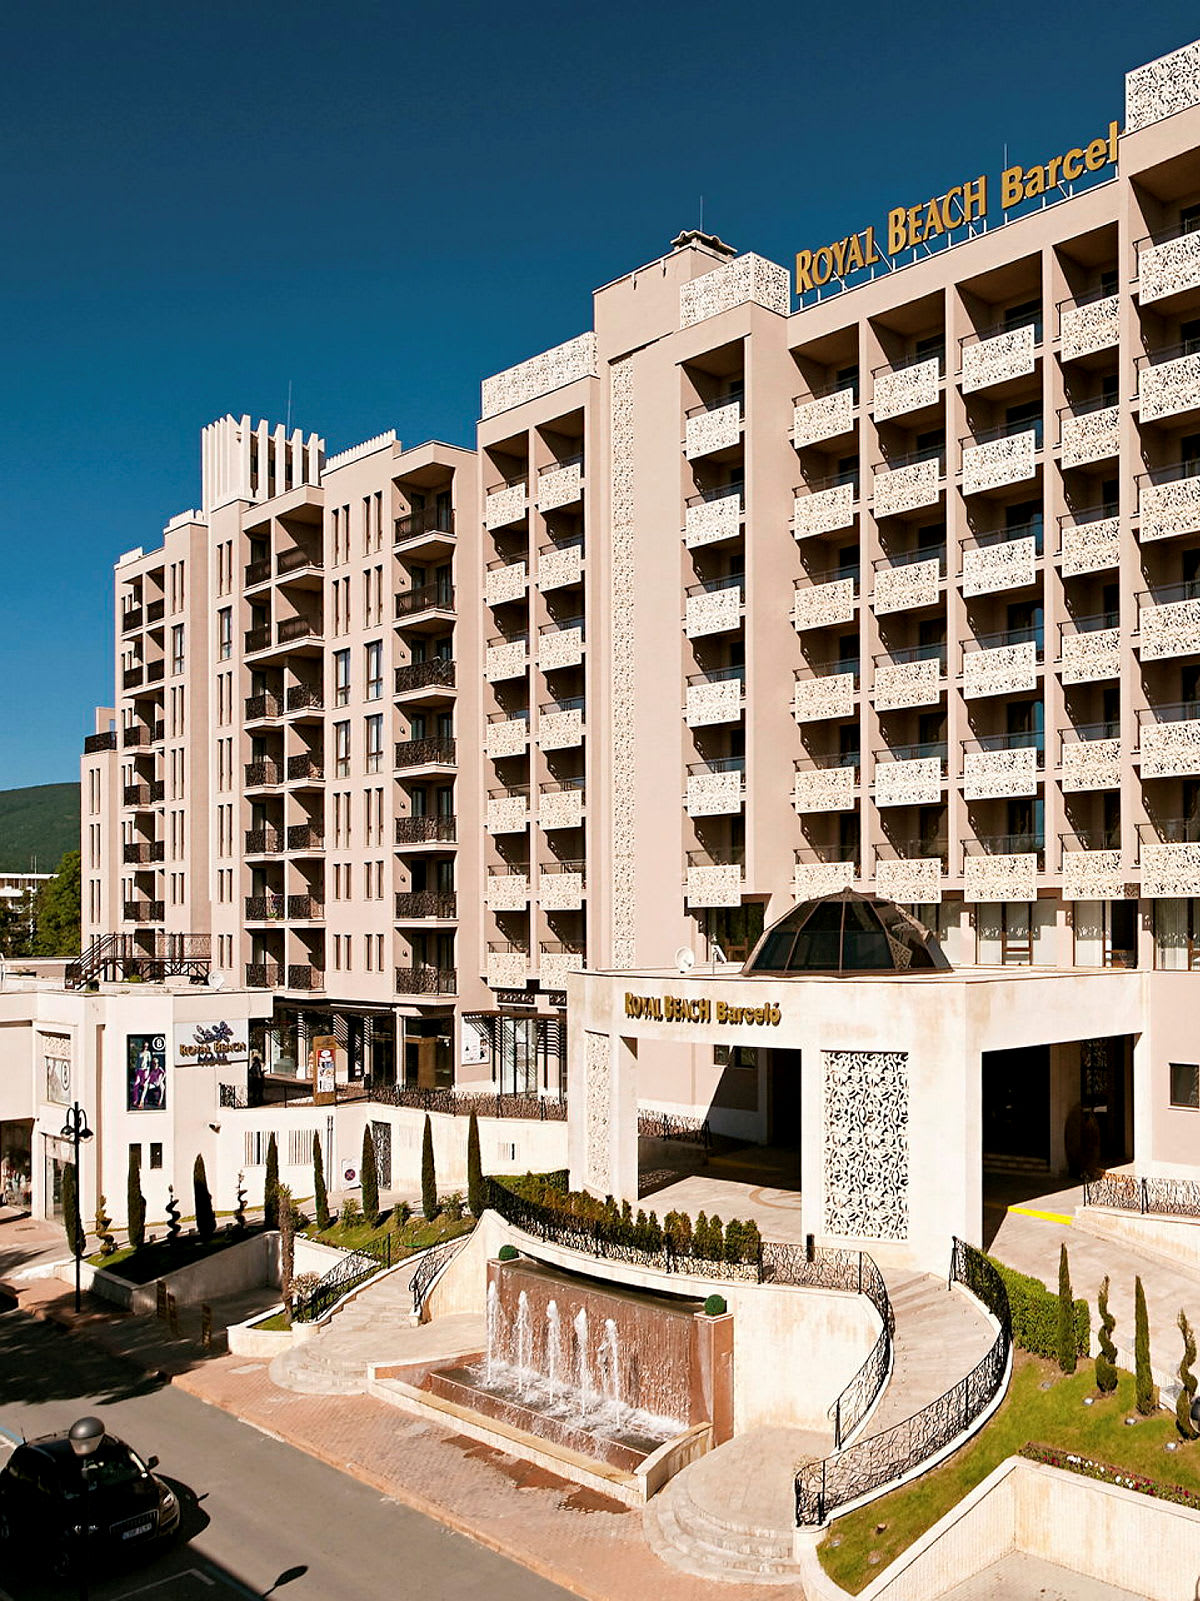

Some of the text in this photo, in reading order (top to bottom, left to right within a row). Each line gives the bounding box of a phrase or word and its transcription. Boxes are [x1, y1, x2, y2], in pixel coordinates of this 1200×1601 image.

[796, 120, 1126, 294] ROYAL BEACH Barcel
[625, 992, 782, 1027] ROYAL BEACH Barceló
